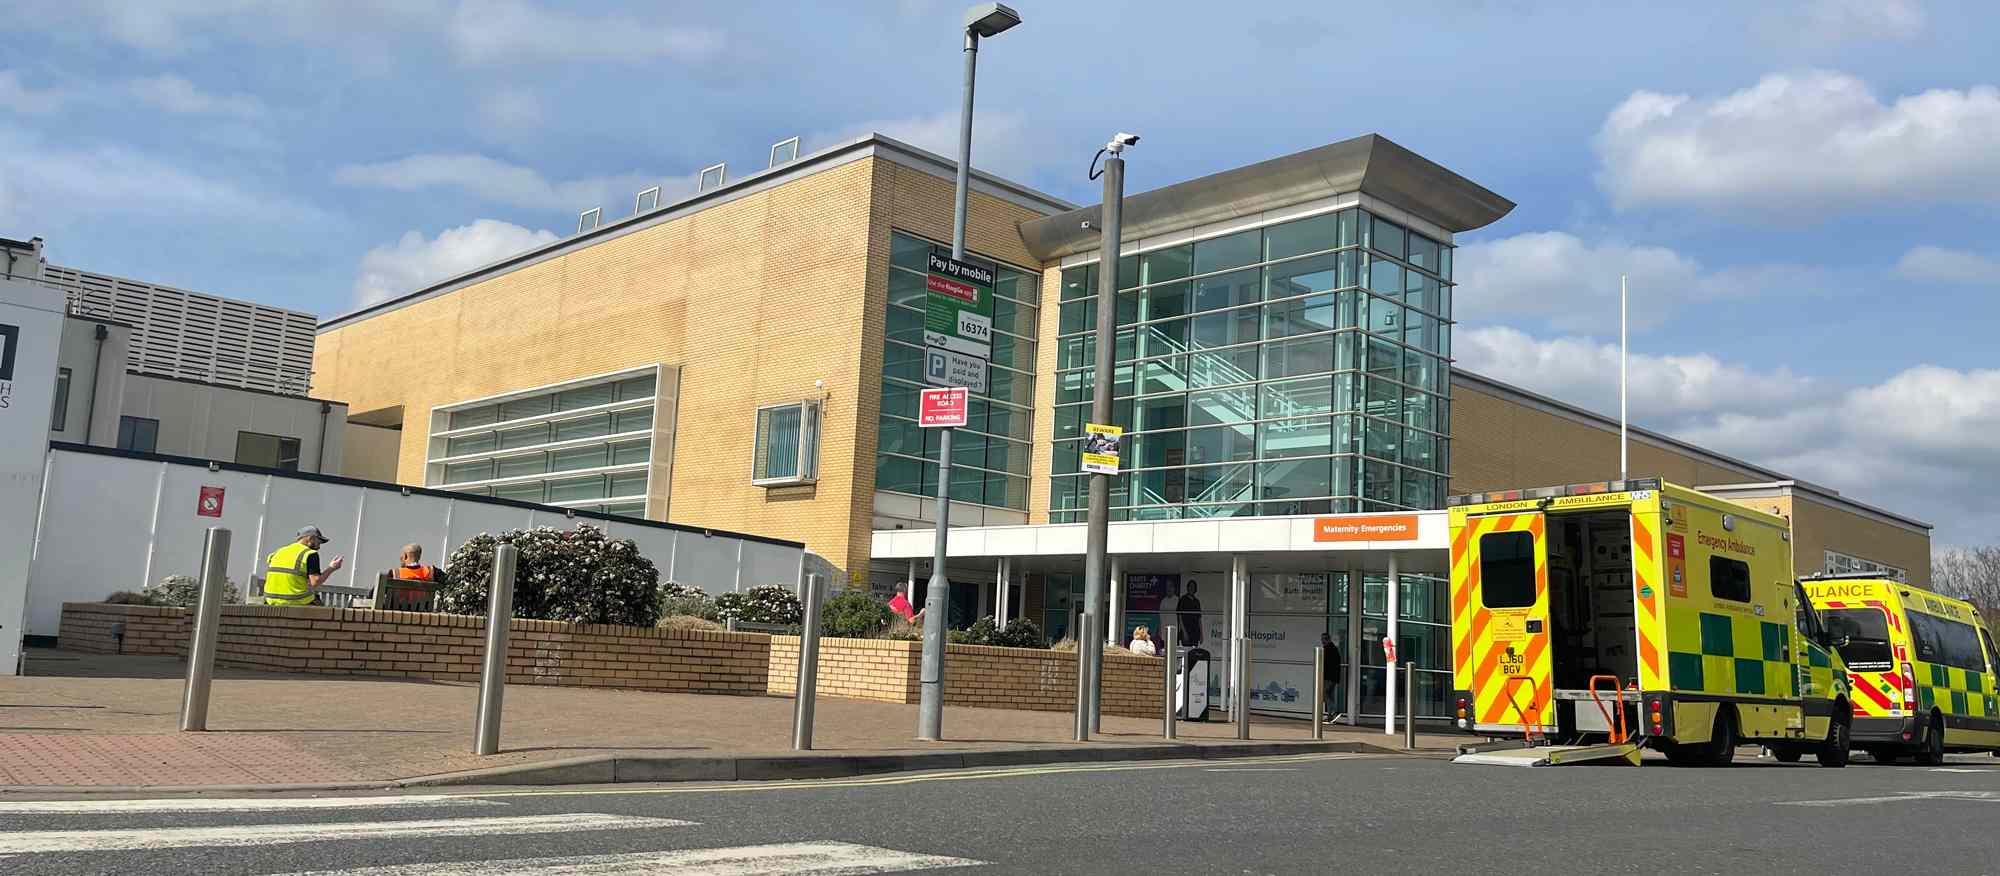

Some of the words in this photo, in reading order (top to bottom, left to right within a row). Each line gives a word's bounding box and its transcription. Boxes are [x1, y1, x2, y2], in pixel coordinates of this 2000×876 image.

[930, 255, 947, 271] Pay
[949, 260, 960, 275] by
[961, 268, 991, 283] mobile
[961, 321, 988, 337] 16374
[952, 355, 968, 366] Have
[969, 361, 980, 370] you
[952, 367, 966, 376] paid
[967, 370, 979, 378] and
[1486, 502, 1528, 511] LONDON
[1558, 493, 1625, 505] AMBULANCE
[1323, 525, 1359, 534] Maternity
[1361, 523, 1407, 533] Emergencies
[1697, 530, 1727, 552] Emergency
[1728, 537, 1755, 555] Ambulance
[1804, 585, 1873, 598] ULANCE
[1250, 630, 1286, 642] Hospital
[1503, 665, 1521, 674] BGV
